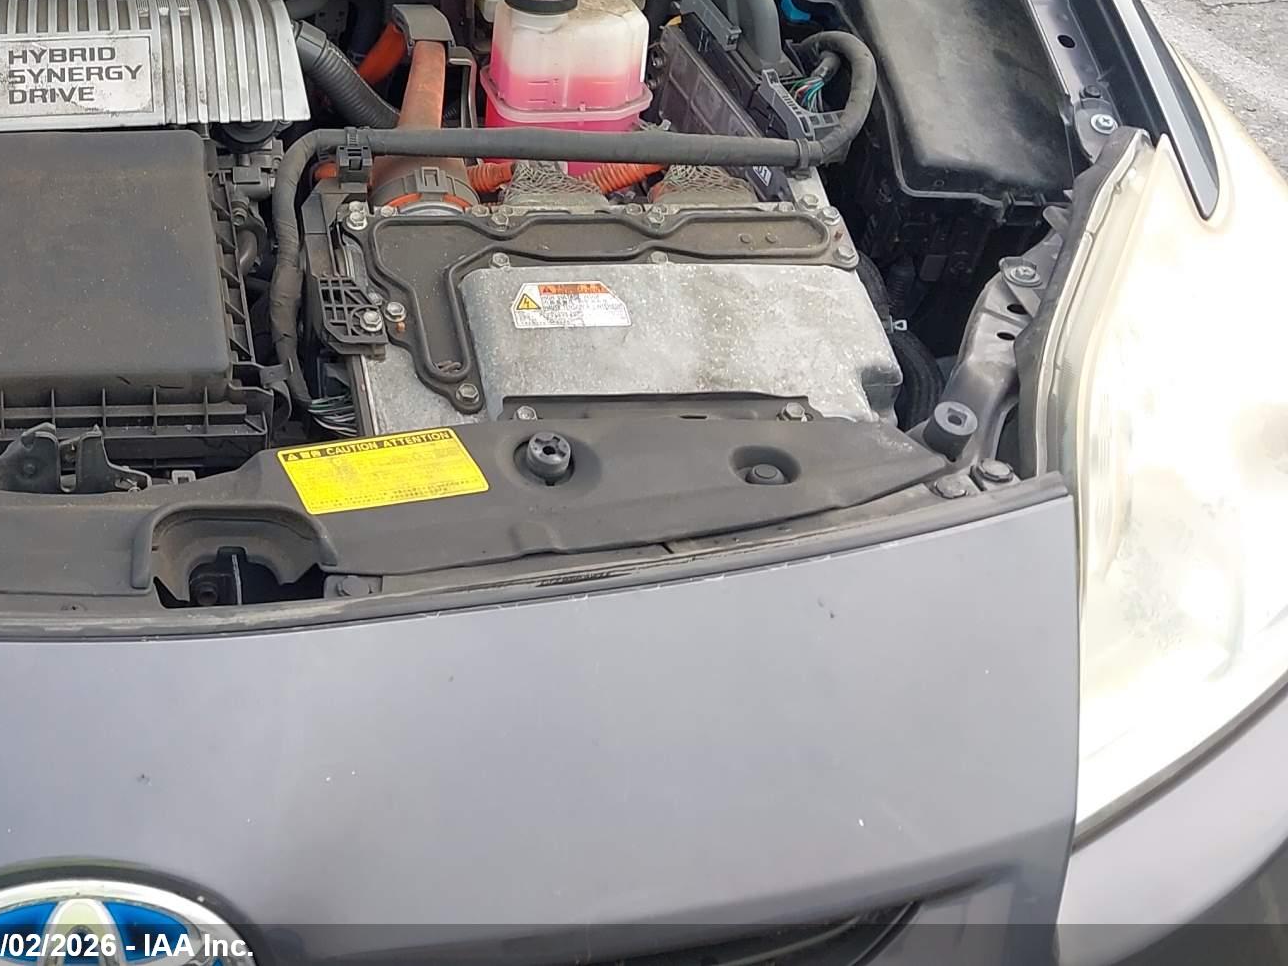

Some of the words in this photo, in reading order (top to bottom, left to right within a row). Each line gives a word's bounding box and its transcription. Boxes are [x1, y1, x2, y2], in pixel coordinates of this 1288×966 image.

[8, 47, 116, 64] HYBRID
[8, 65, 143, 84] SYNERGY
[8, 86, 95, 104] DRIVE
[326, 441, 379, 457] CAUTION
[383, 431, 450, 449] ATTENTION
